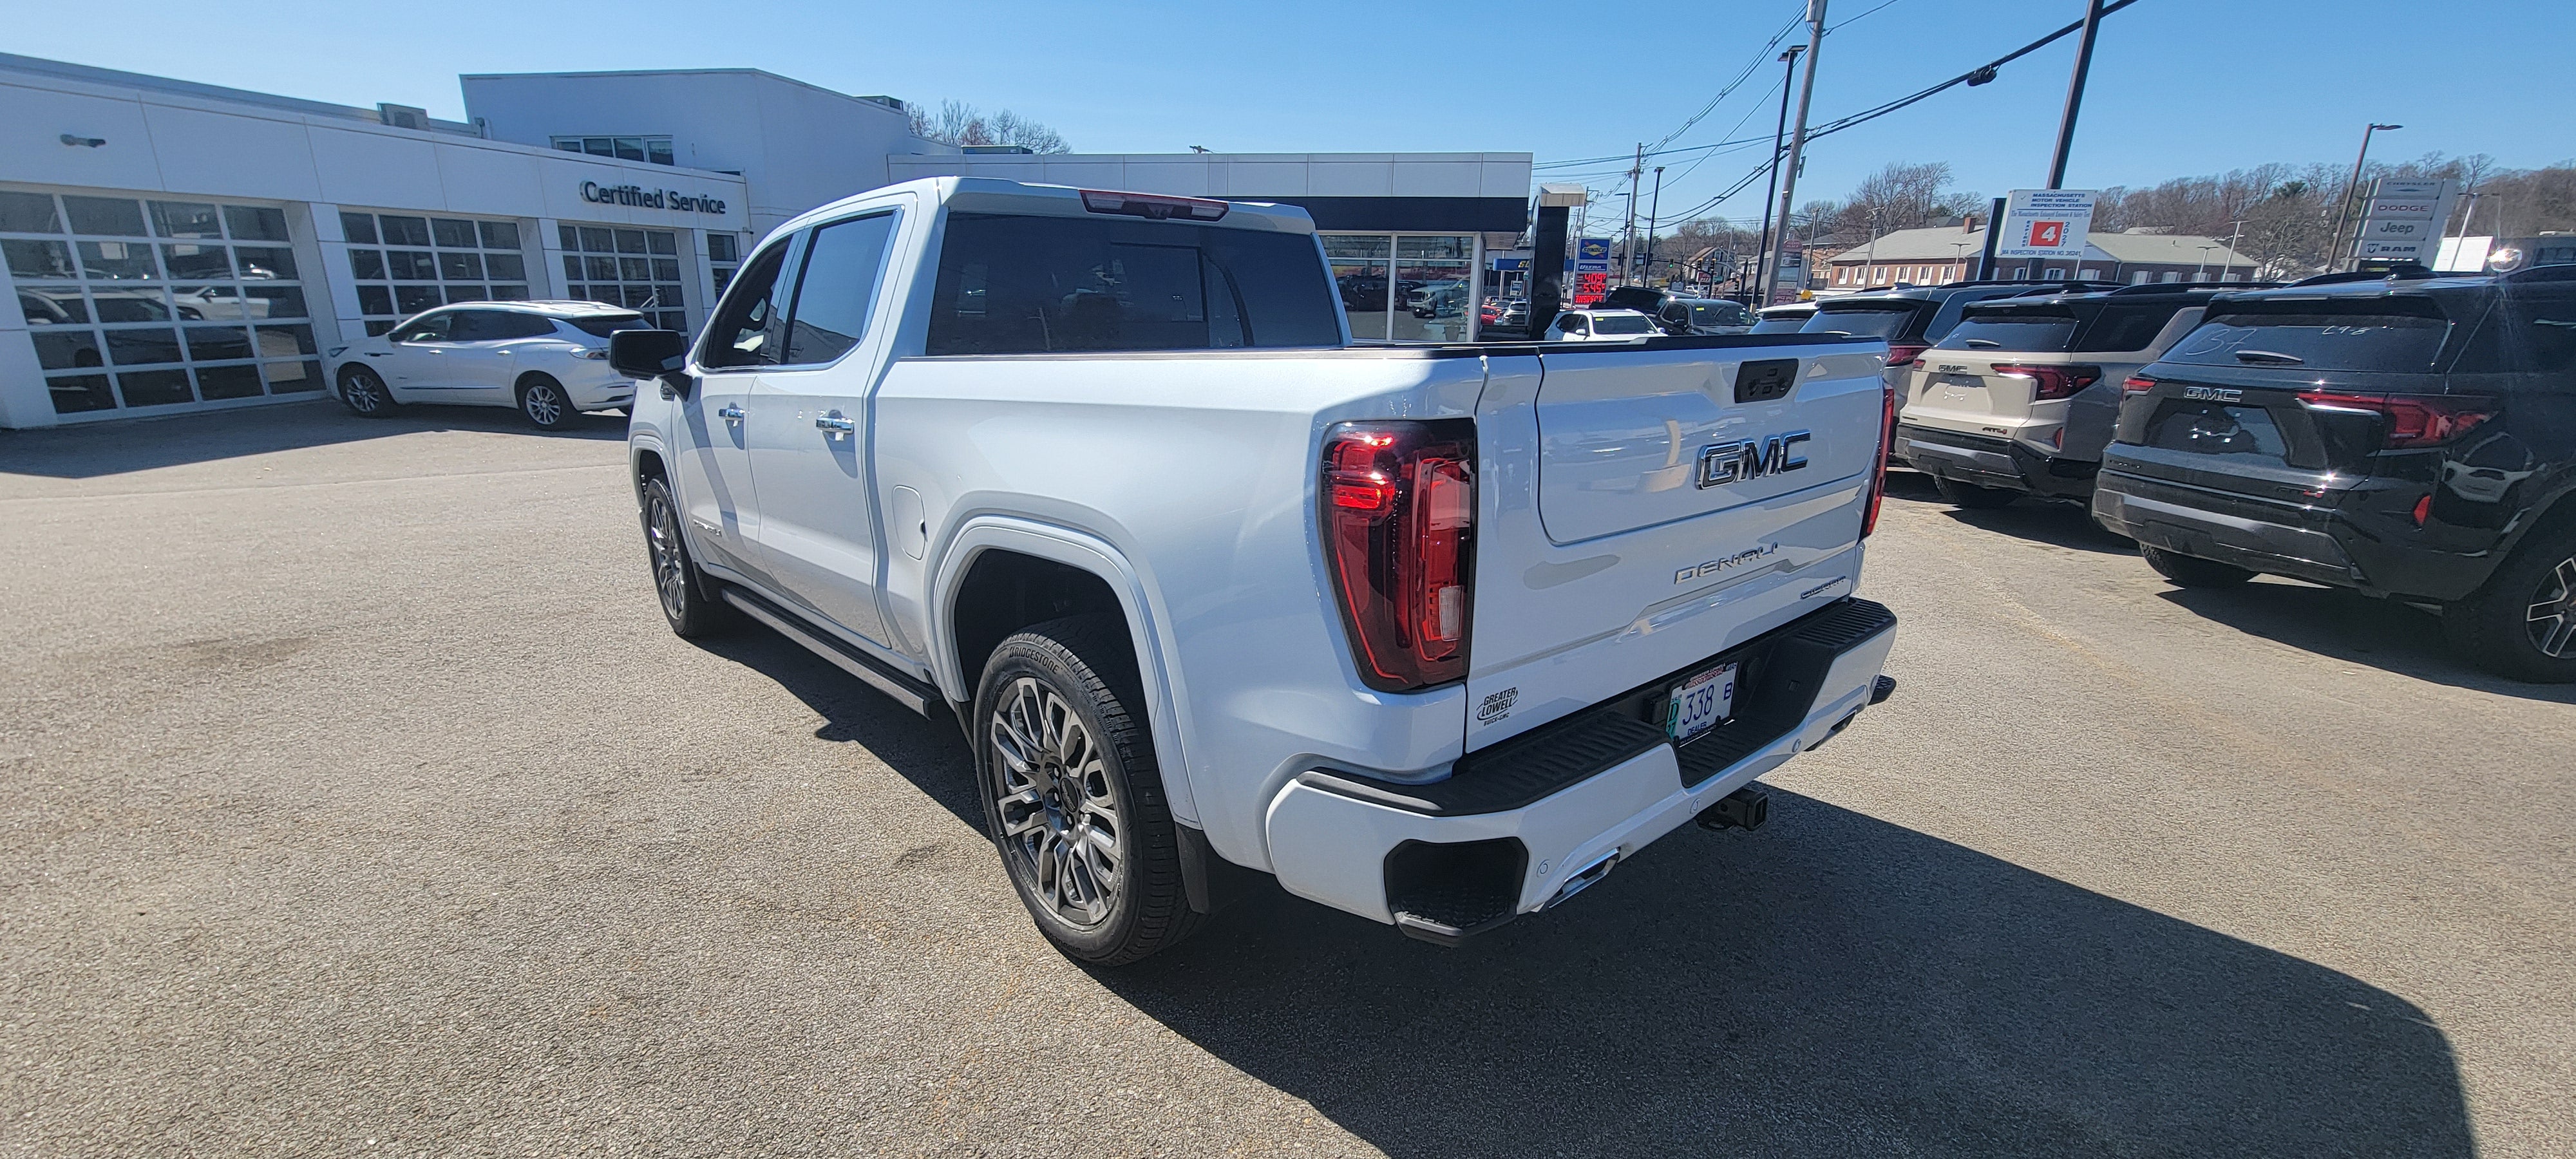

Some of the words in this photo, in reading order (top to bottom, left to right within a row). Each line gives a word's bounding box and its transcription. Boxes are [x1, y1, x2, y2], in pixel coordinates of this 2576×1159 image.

[583, 180, 665, 209] Certified
[668, 191, 726, 214] Service
[2041, 226, 2057, 242] 4
[2380, 222, 2414, 234] Jeep
[1938, 364, 1967, 374] GMC
[2184, 386, 2243, 403] GMC
[1694, 429, 1811, 490] GMC
[1674, 542, 1778, 585] DENALI
[1009, 646, 1060, 675] BRIDGESTONE
[1484, 687, 1517, 706] GREATER
[1682, 684, 1714, 725] 338
[1723, 682, 1733, 701] B
[1481, 697, 1513, 717] LOWELL
[1687, 721, 1707, 735] DEALER
